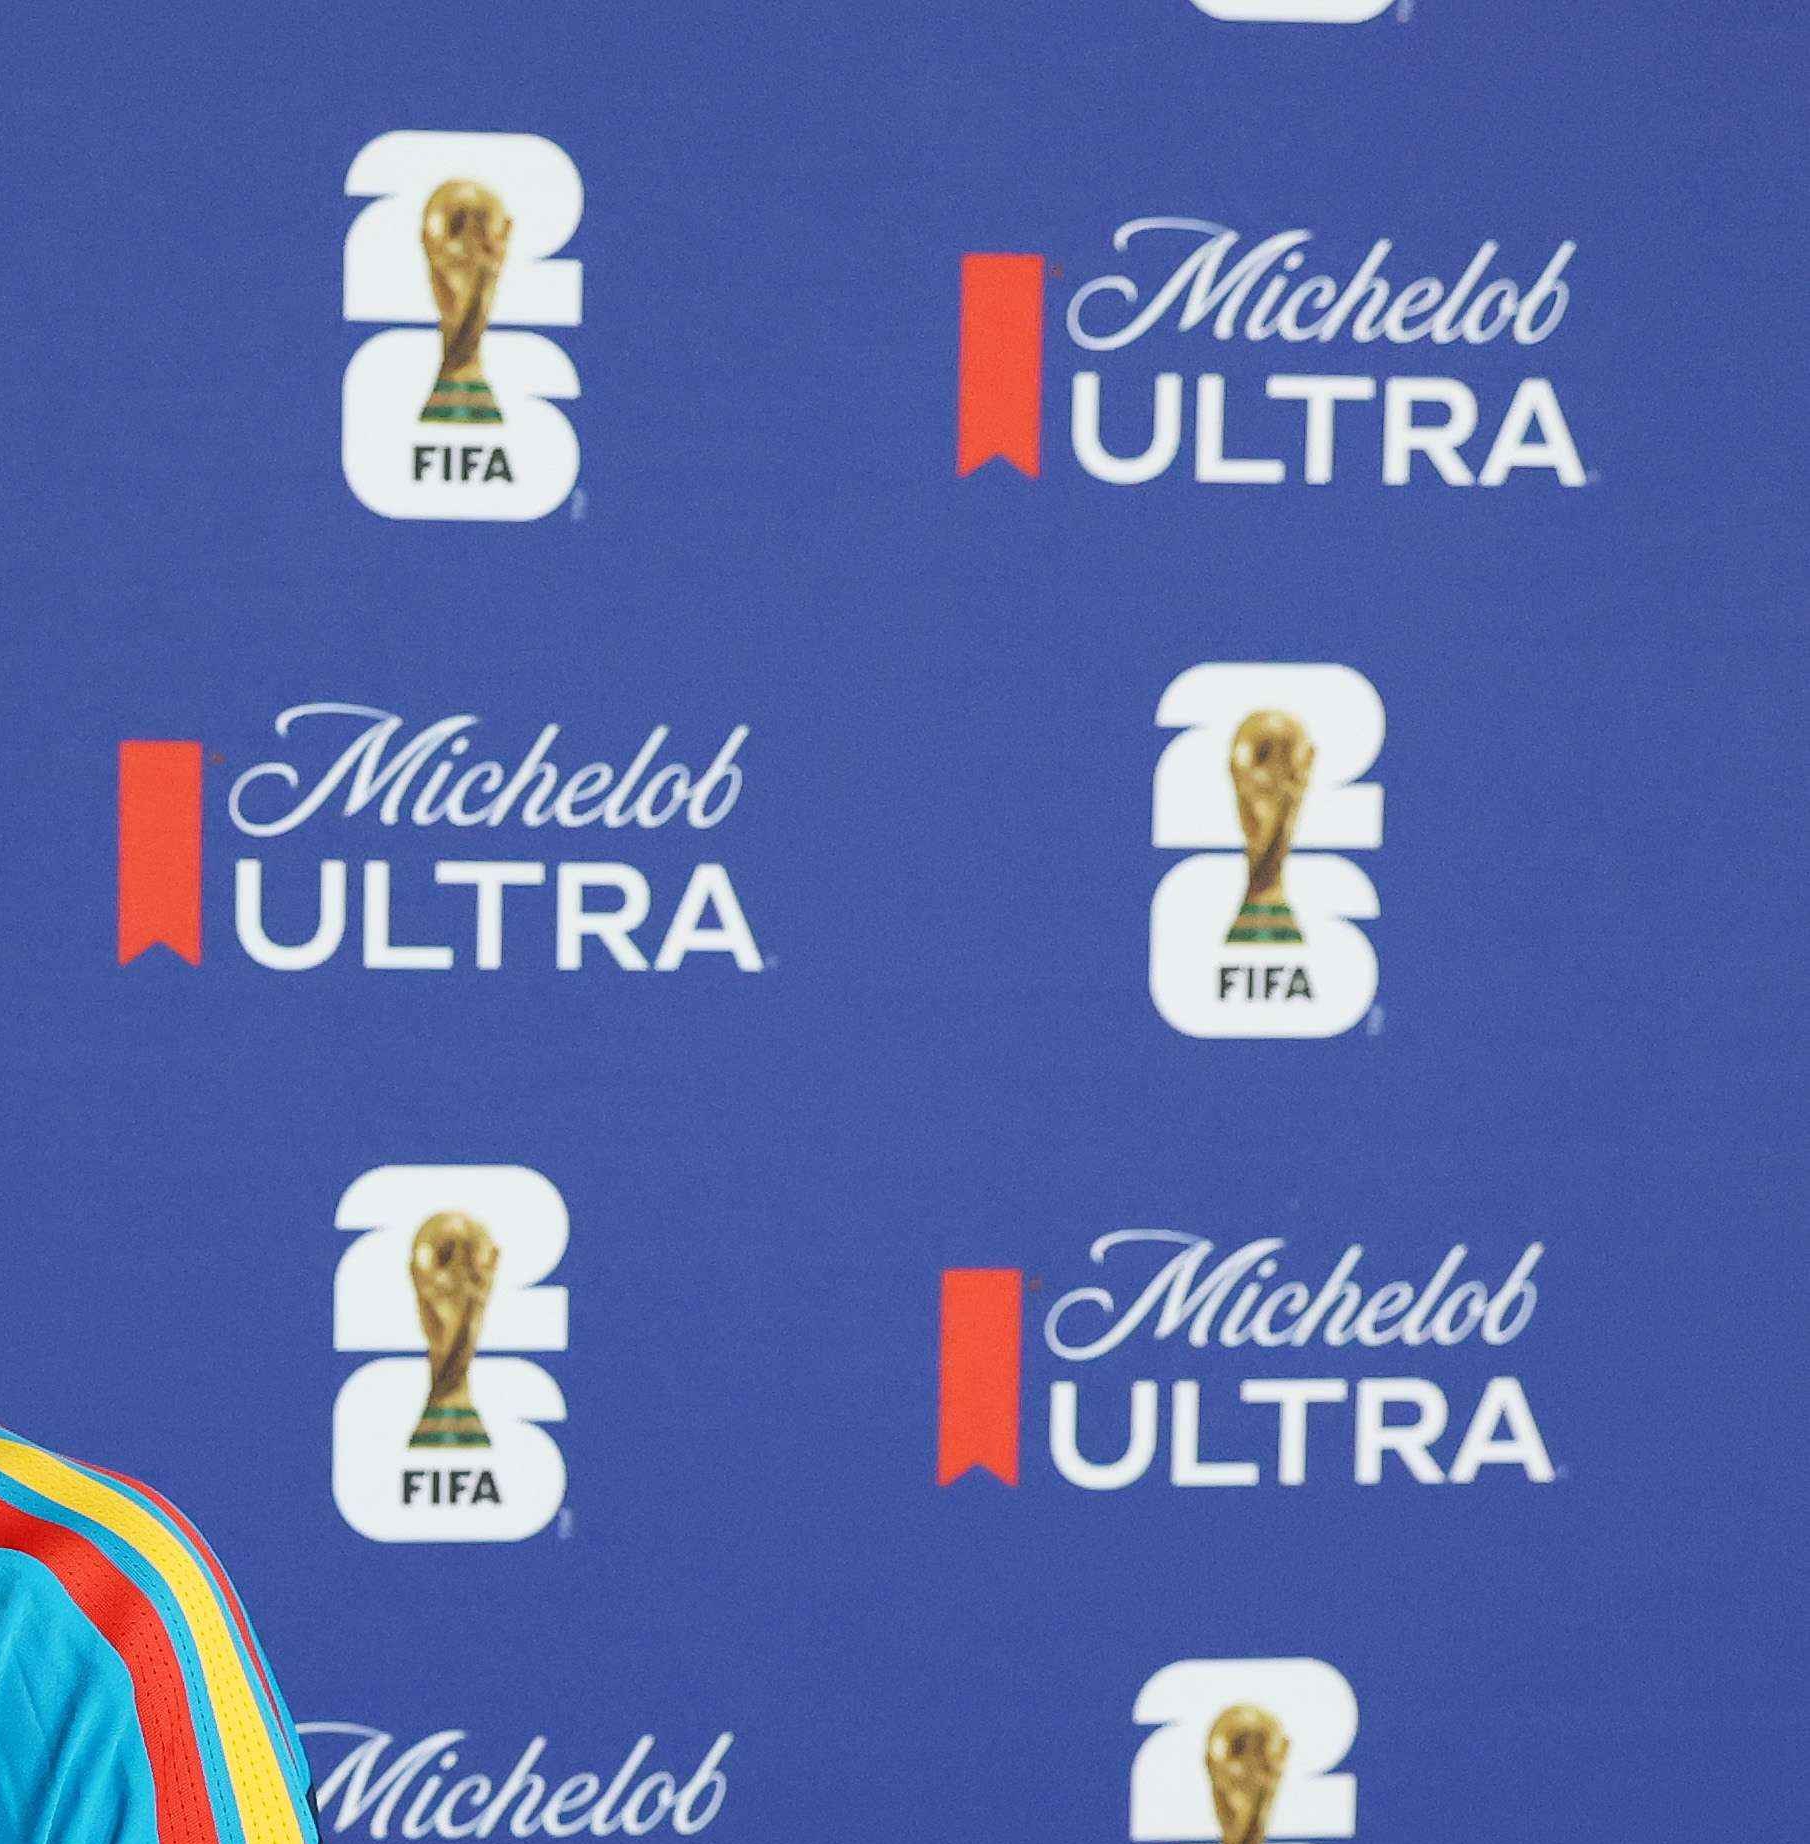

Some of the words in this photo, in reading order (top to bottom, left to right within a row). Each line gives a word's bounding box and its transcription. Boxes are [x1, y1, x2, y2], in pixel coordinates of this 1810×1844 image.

[1066, 216, 1577, 352] Michelob
[413, 445, 514, 483] FIFA
[1071, 370, 1596, 488] ULTRA
[228, 702, 750, 838] Michelob
[234, 858, 766, 973] ULTRA
[1218, 965, 1313, 1001] FIFA
[1044, 1229, 1545, 1362] Michelob
[402, 1469, 502, 1506] FIFA
[1048, 1376, 1561, 1491] ULTRA
